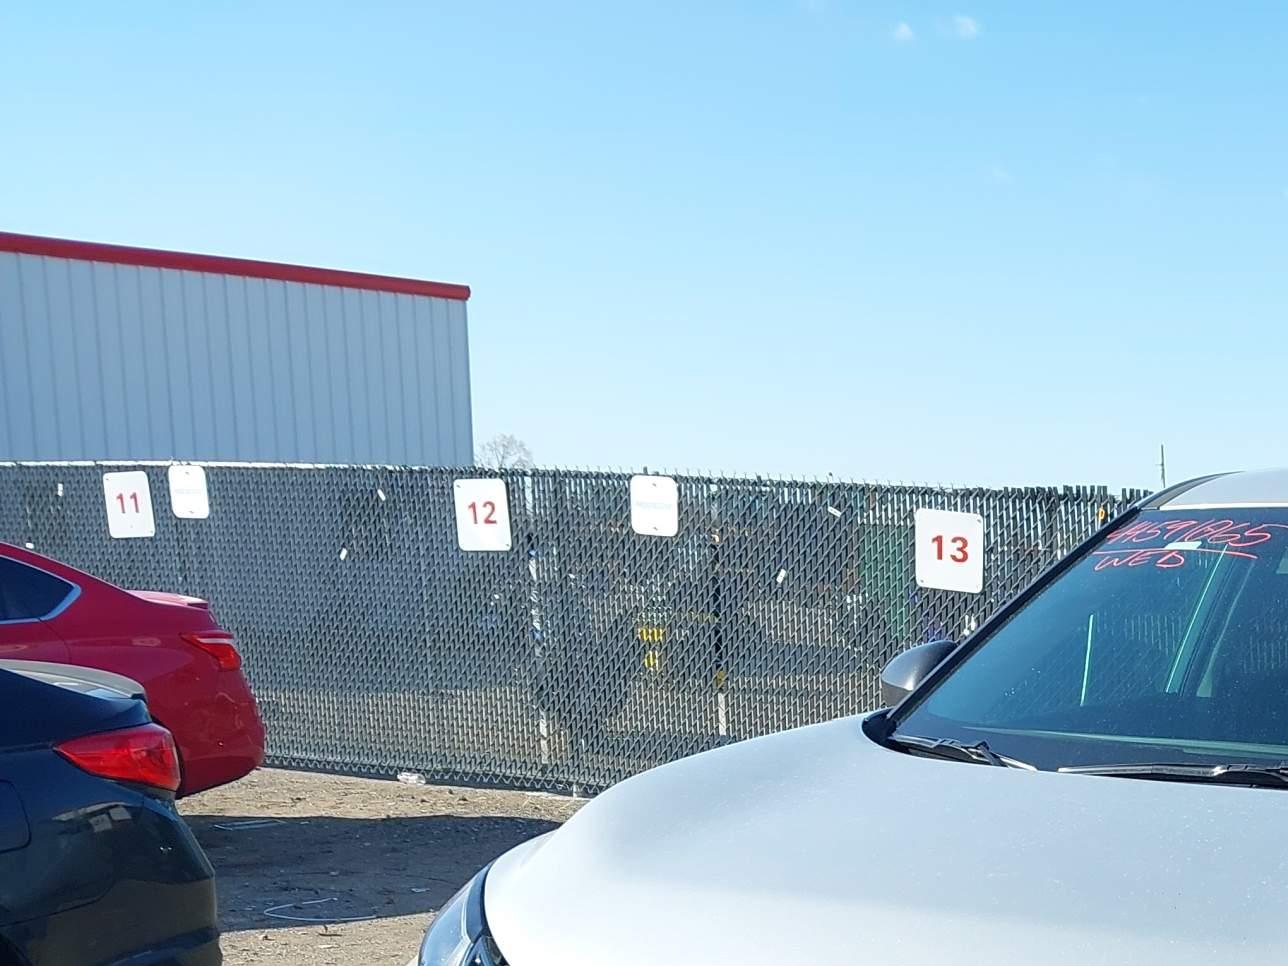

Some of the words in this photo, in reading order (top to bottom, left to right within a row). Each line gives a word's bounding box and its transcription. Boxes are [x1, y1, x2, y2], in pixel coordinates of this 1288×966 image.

[116, 492, 140, 514] 11
[467, 500, 498, 525] 12
[931, 534, 969, 564] 13
[1094, 549, 1185, 571] WED
